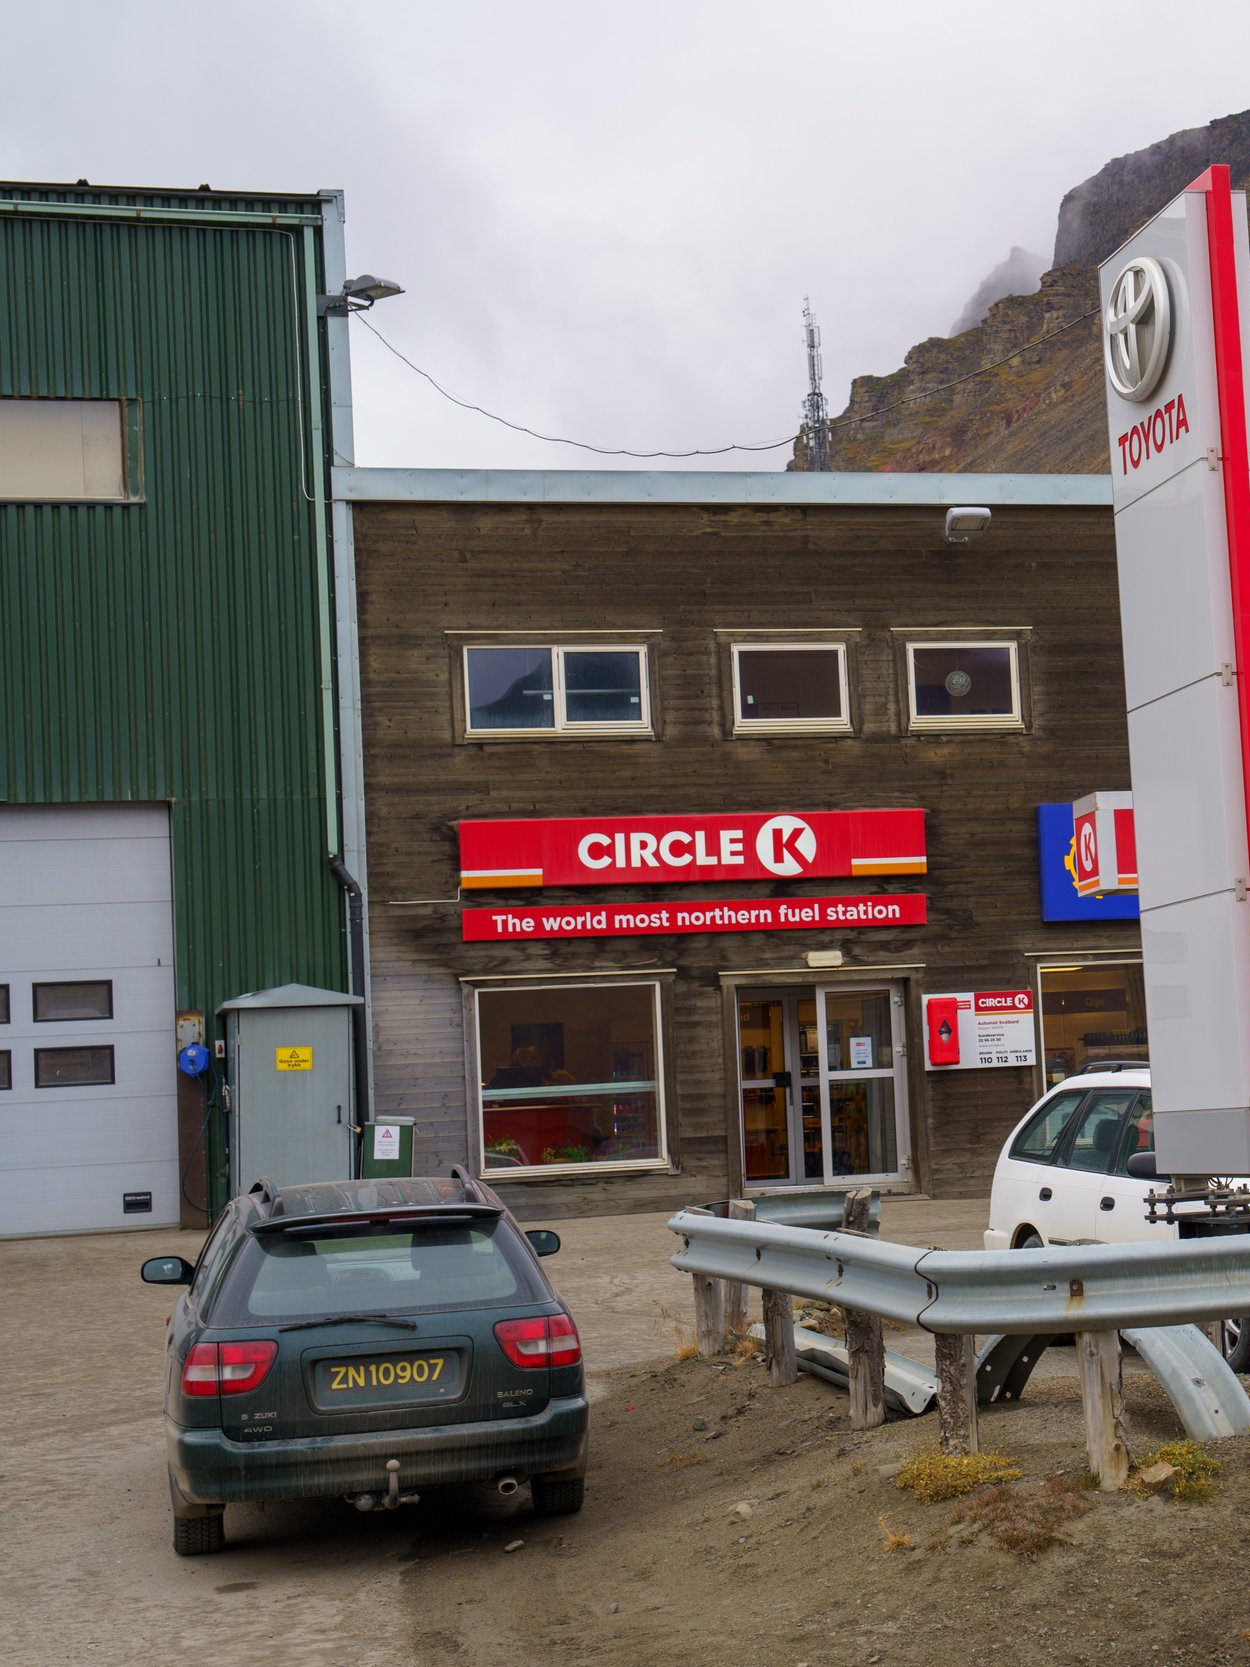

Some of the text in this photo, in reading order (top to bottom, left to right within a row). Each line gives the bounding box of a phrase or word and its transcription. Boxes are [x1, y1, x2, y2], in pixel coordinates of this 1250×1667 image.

[1118, 393, 1190, 476] TOYOTA
[577, 825, 815, 873] CIRCLE K
[492, 901, 900, 932] The world most northern fuel station
[978, 997, 1013, 1007] CIRCLE
[979, 1054, 1028, 1065] 110 112 113
[497, 1388, 534, 1398] BALENO
[502, 1400, 527, 1408] GLX
[244, 1425, 273, 1433] 4WD
